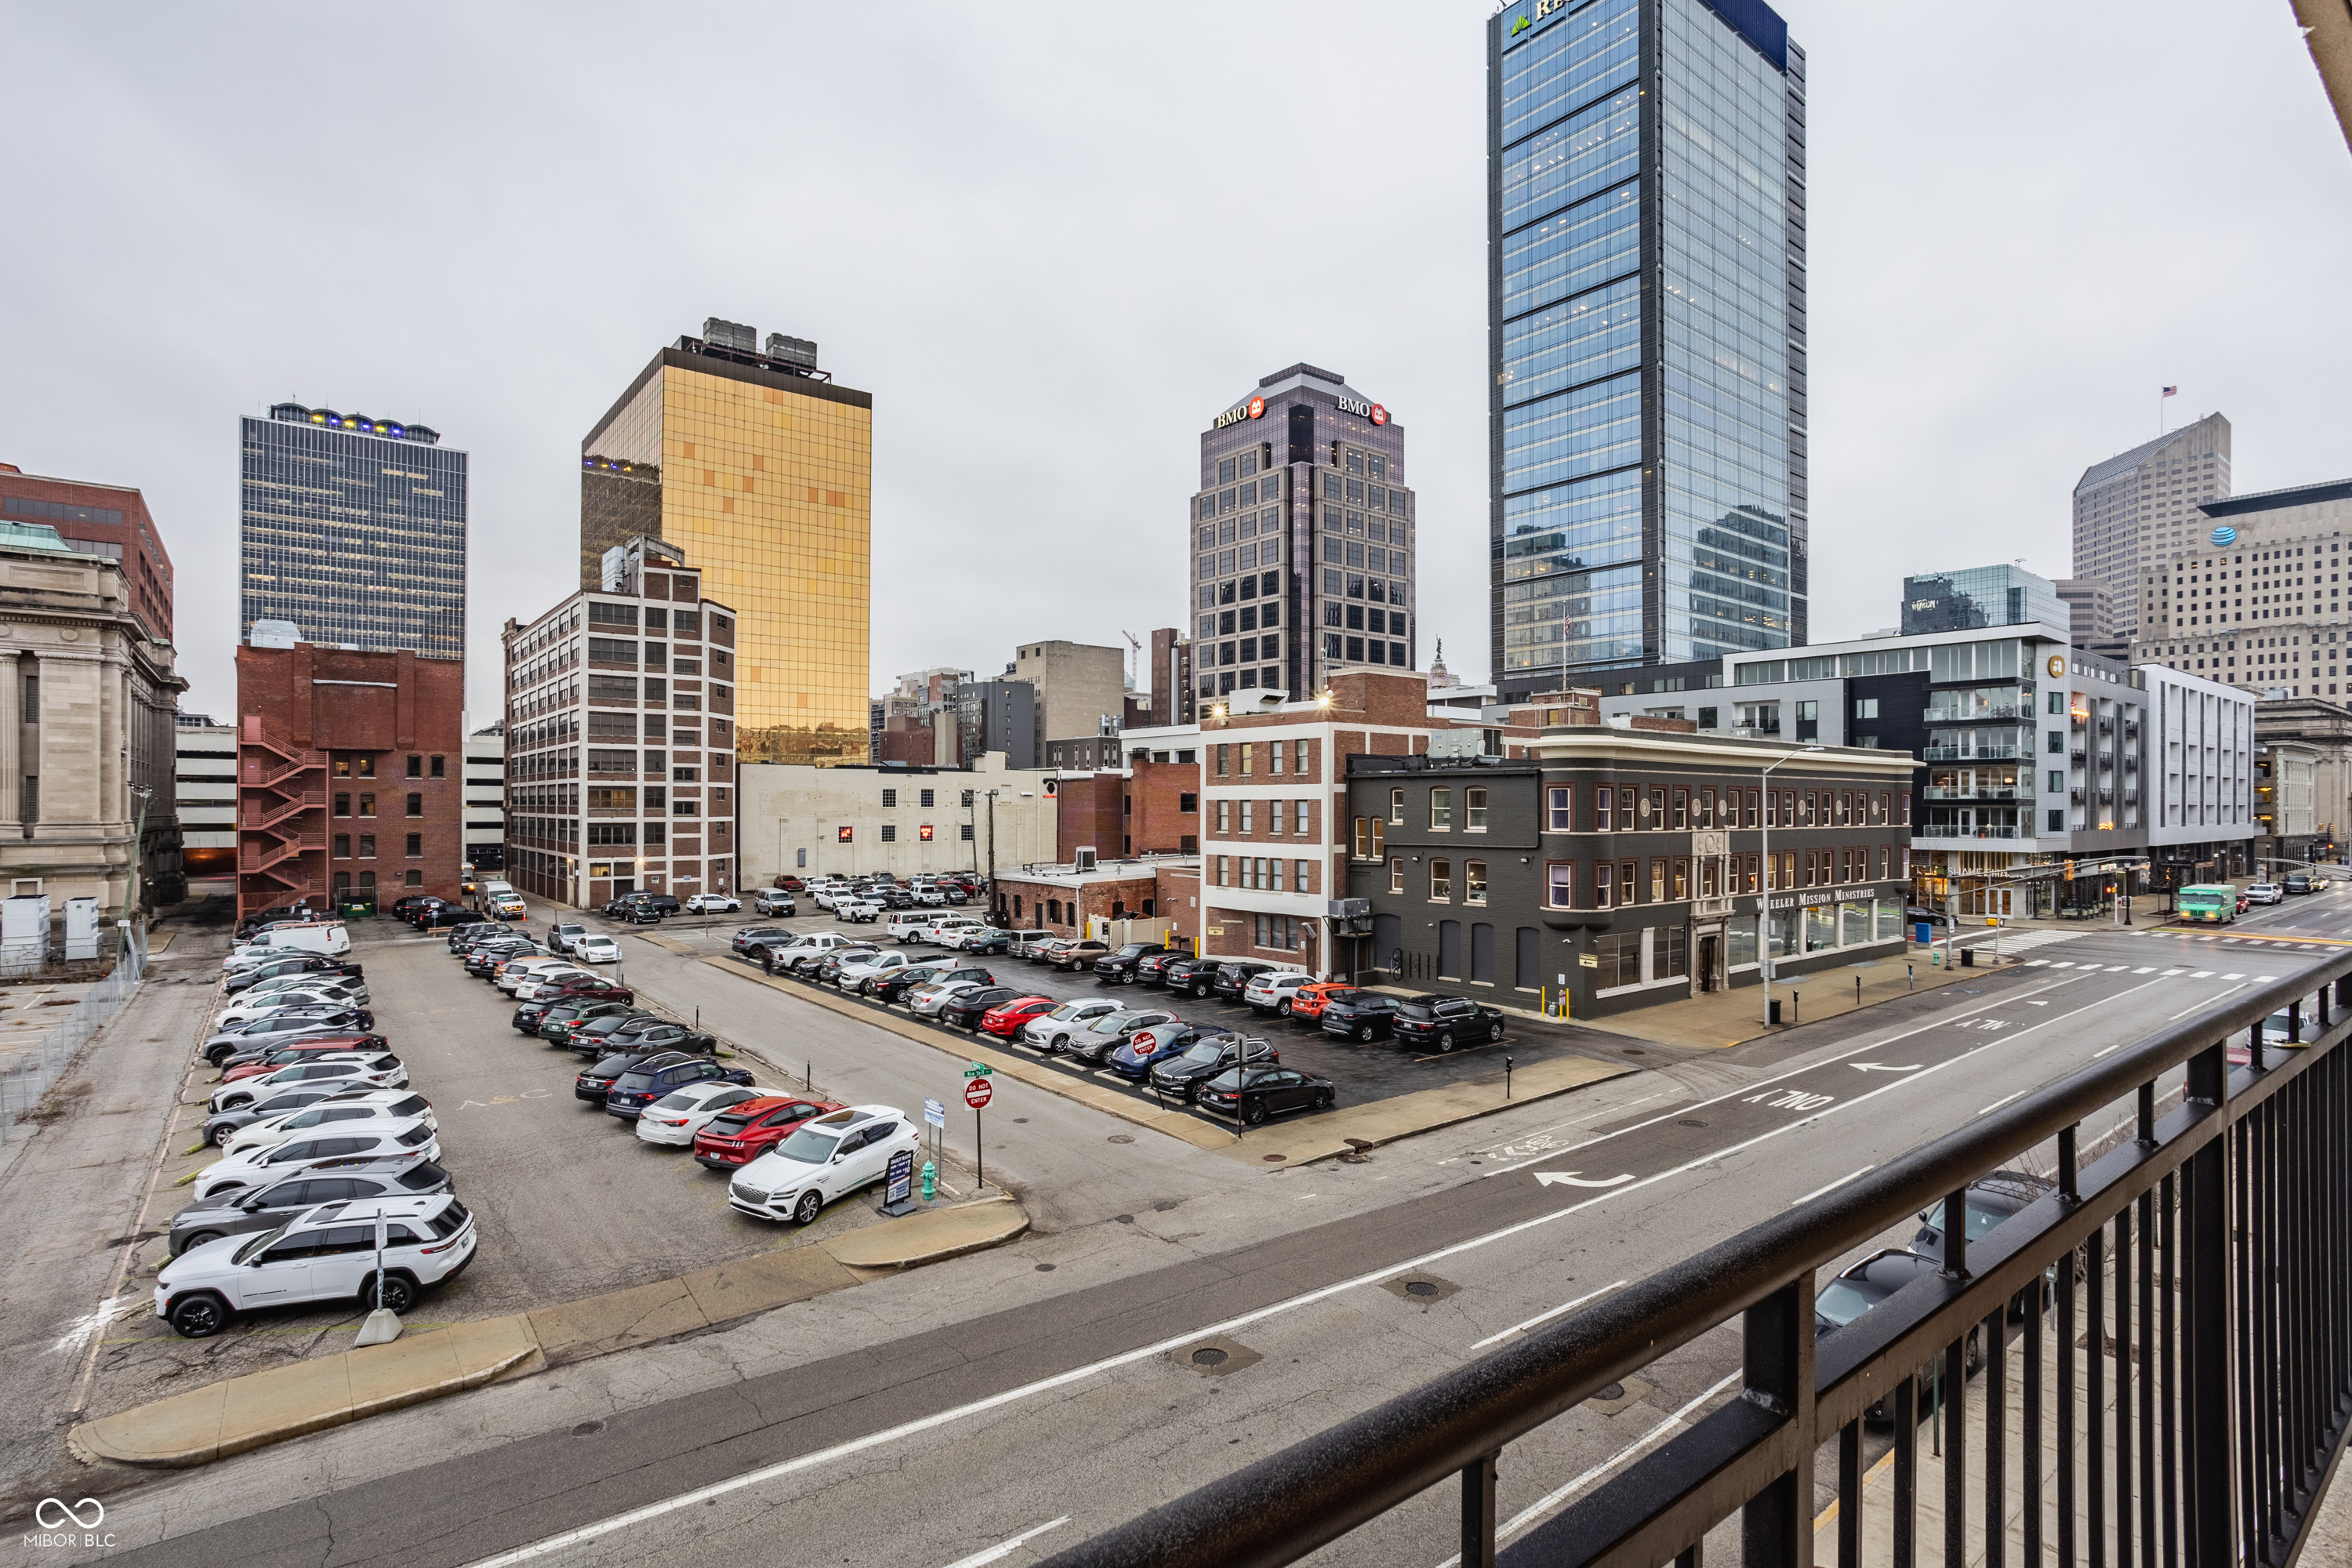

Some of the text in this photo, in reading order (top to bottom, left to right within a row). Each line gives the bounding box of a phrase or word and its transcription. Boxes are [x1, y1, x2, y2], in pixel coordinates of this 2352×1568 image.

[1338, 395, 1370, 417] BMO
[1217, 405, 1247, 429] BMO
[1947, 867, 1984, 877] SHAKE
[1755, 888, 1875, 911] WEELER MISSION MINISTRIES
[1139, 1044, 1152, 1053] ENTER
[902, 1152, 912, 1161] RATE
